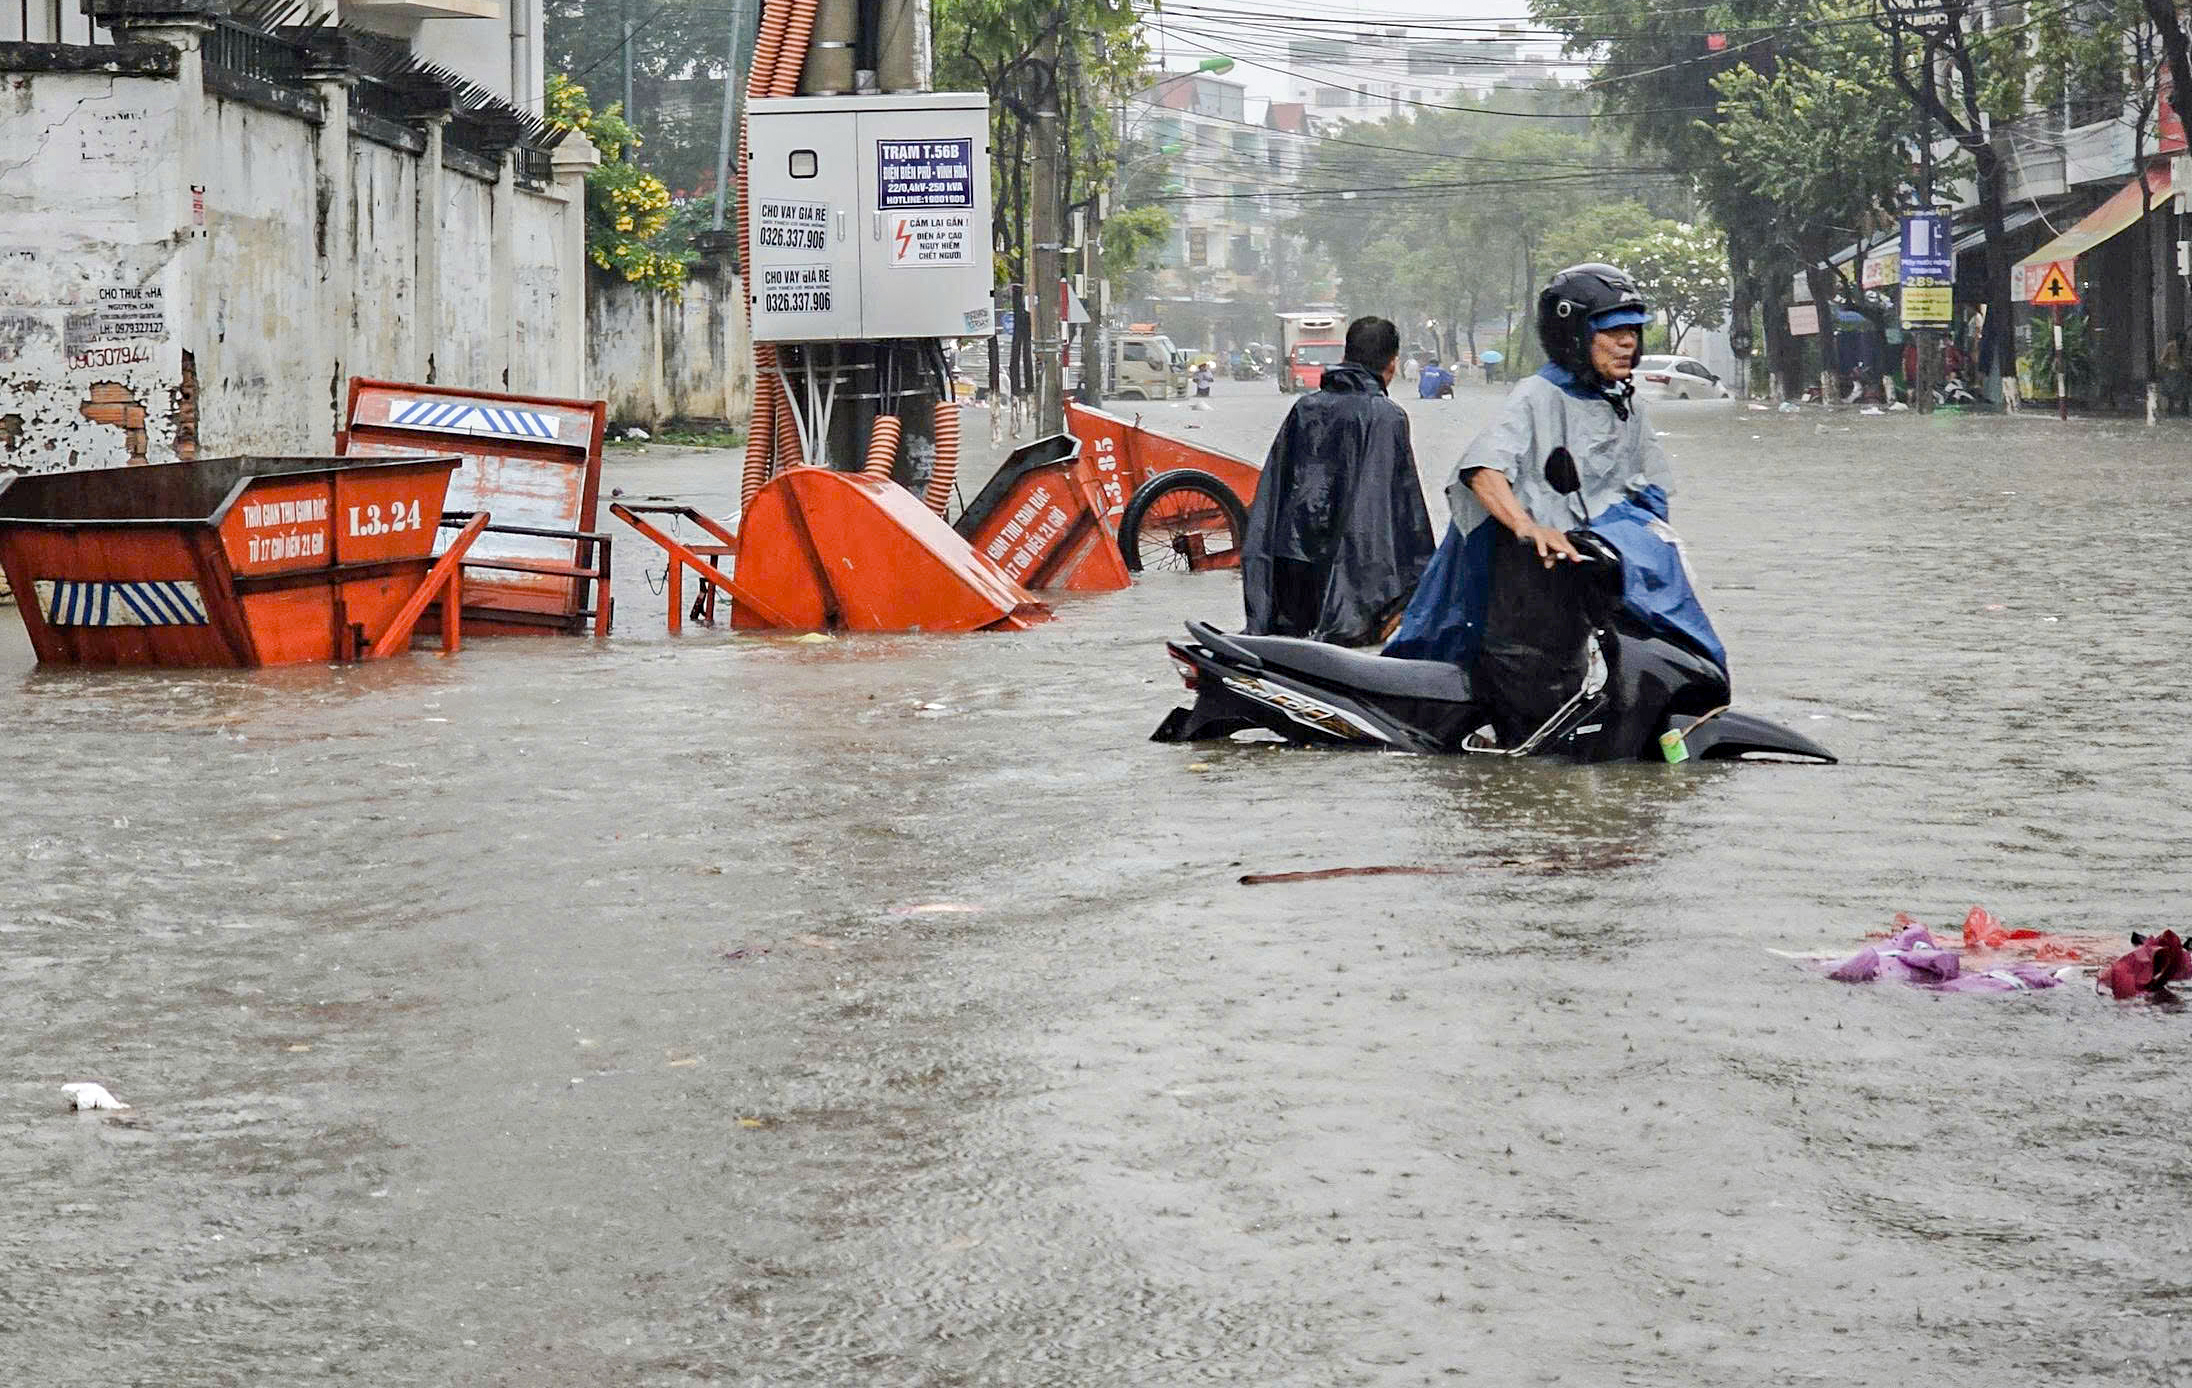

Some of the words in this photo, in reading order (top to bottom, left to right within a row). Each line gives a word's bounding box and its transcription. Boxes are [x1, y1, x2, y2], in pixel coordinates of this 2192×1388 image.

[882, 145, 920, 162] TRẠM
[923, 144, 960, 159] T.56B
[762, 204, 778, 218] CHO
[782, 206, 796, 219] VAY
[760, 227, 825, 249] 0326.337.906
[948, 232, 962, 240] CAO
[920, 242, 939, 250] NGUY
[765, 271, 782, 284] CHO
[784, 271, 799, 283] VAY
[100, 288, 117, 300] CHO
[766, 292, 830, 312] 0326.337.906
[100, 324, 113, 334] LH:
[261, 539, 270, 562] 17
[301, 534, 311, 556] 21
[1004, 562, 1021, 580] 17
[1038, 522, 1057, 539] 21
